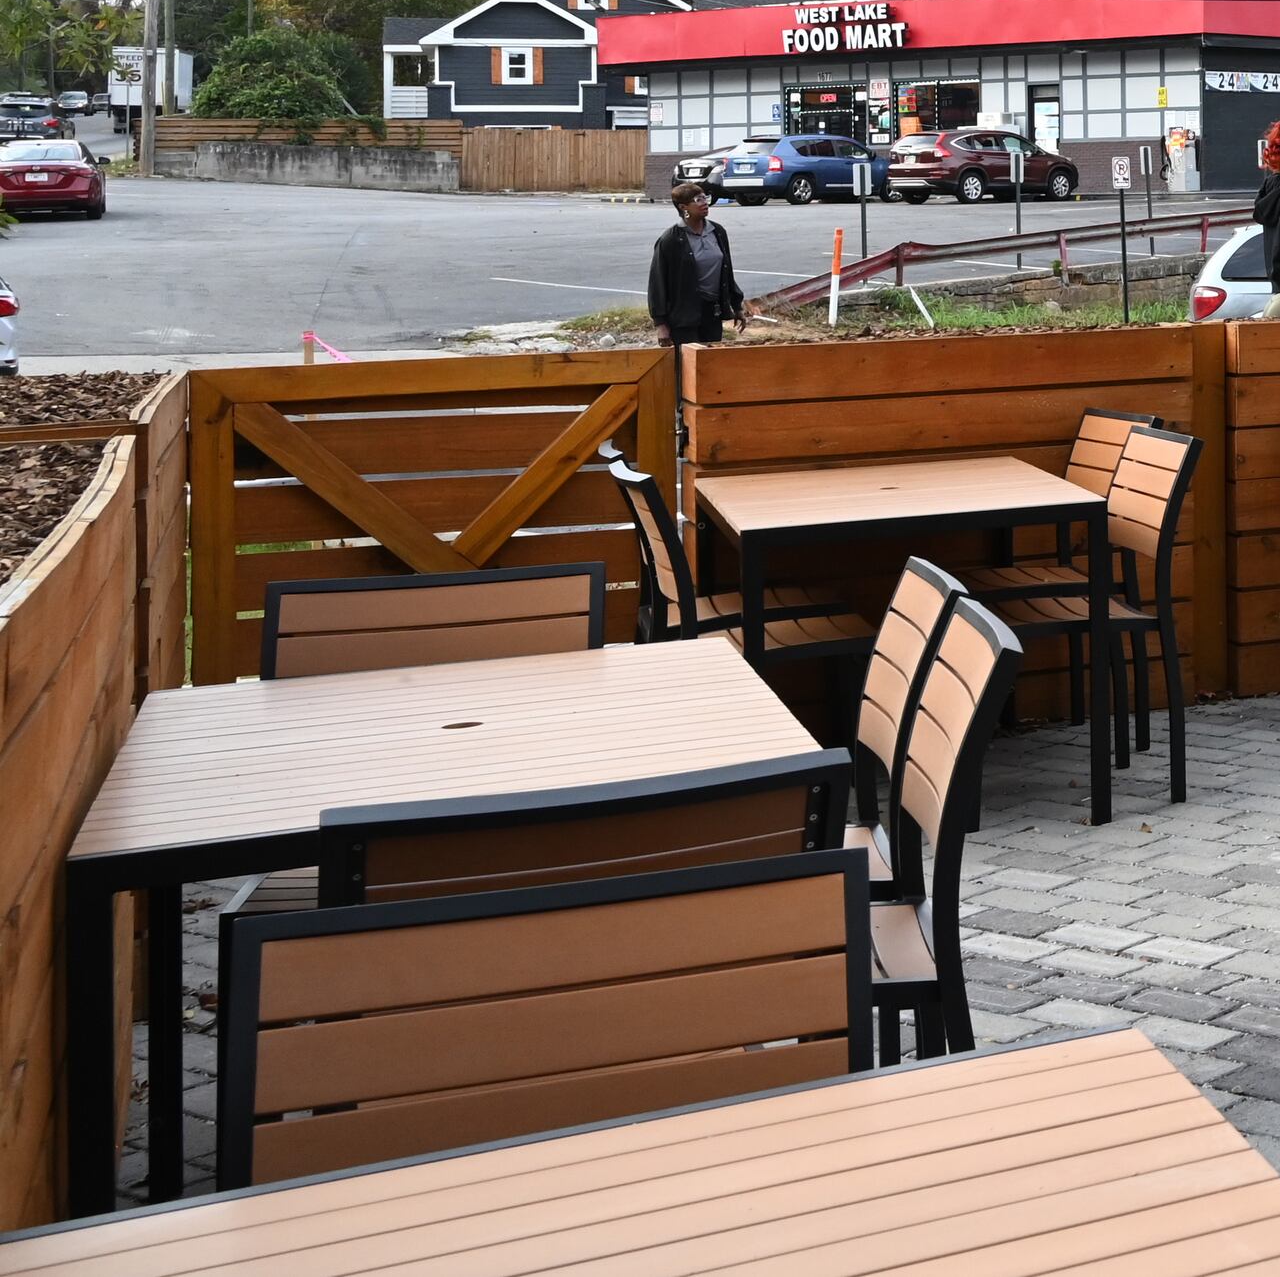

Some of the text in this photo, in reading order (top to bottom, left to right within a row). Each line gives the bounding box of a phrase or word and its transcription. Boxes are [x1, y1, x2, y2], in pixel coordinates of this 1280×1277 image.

[795, 3, 887, 24] WEST LAKE
[782, 22, 905, 53] FOOD MART
[820, 94, 836, 102] OPEN
